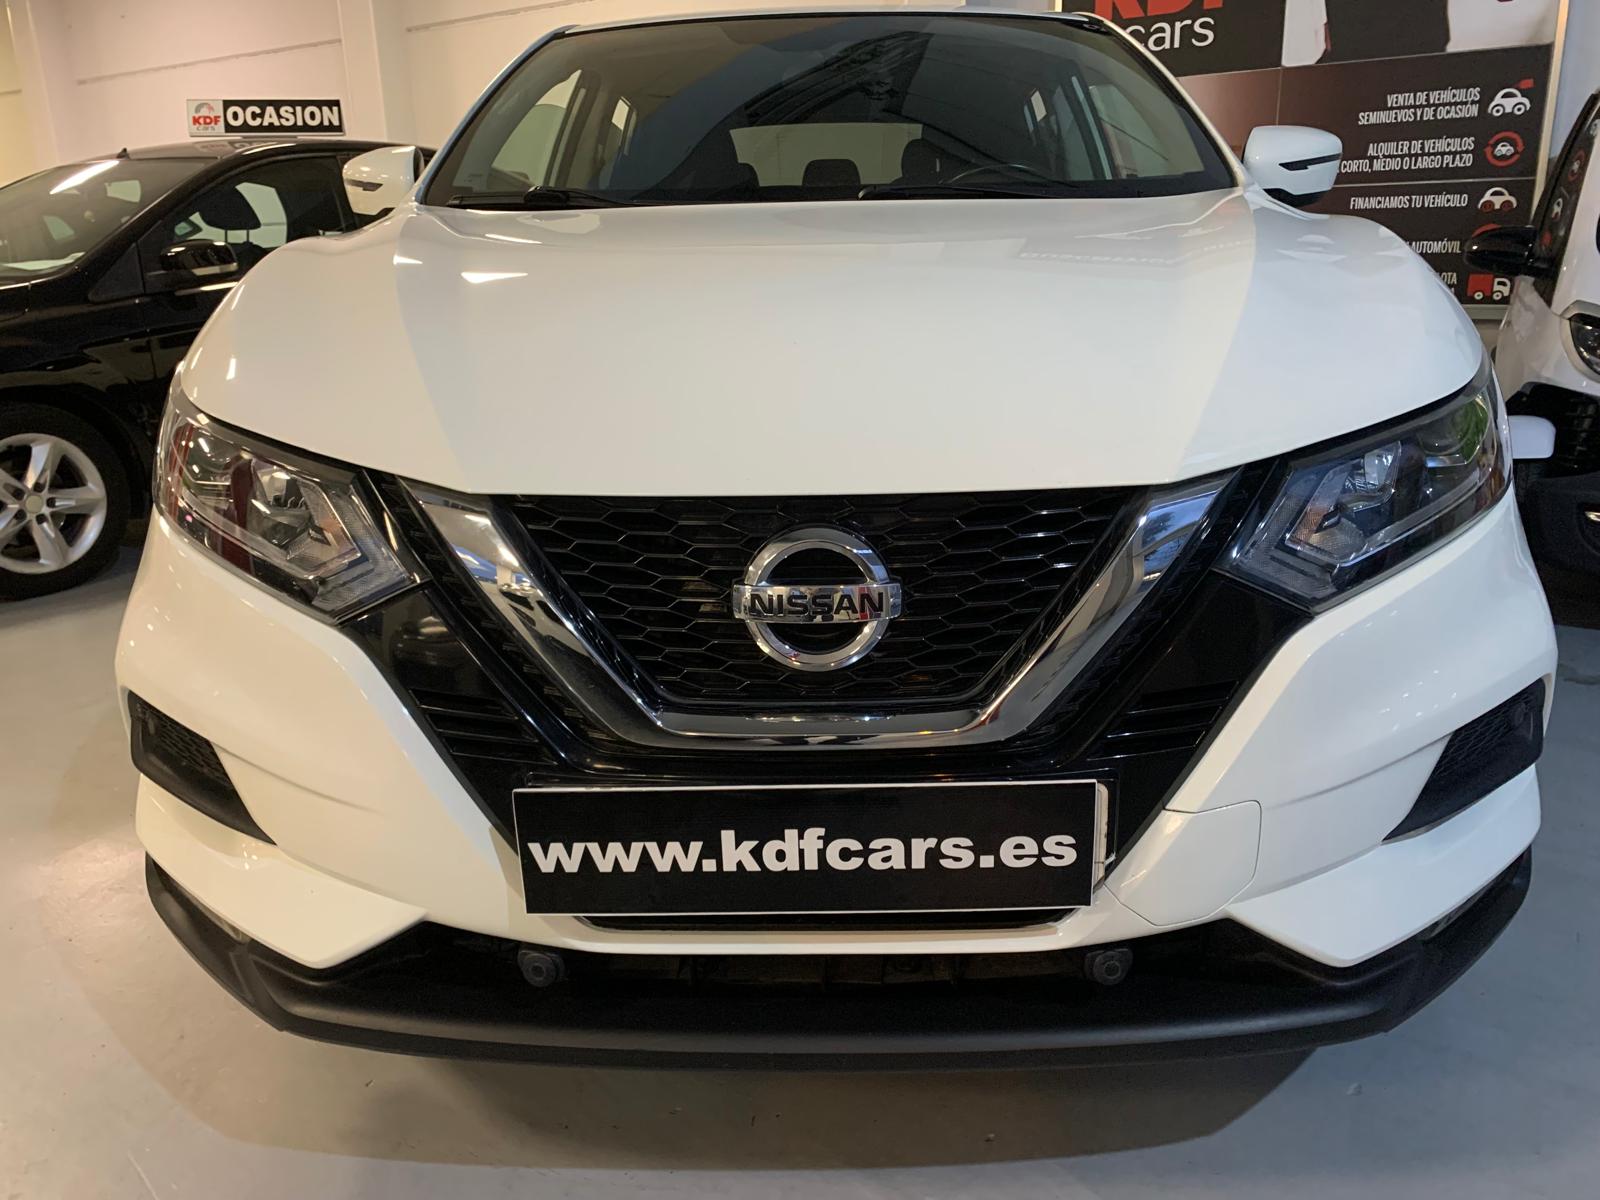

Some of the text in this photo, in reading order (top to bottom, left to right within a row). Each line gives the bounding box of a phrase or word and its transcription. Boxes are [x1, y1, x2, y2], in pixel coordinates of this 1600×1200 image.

[1387, 86, 1481, 107] VENTA DE VEHÍCULOS
[192, 115, 221, 126] KDF
[226, 105, 340, 127] OCASION
[1358, 102, 1479, 125] SEMINUEVOS Y DE OCASIÓN
[1367, 135, 1476, 159] ALQUILER DE VEHÍCULOS
[1341, 153, 1473, 173] CORTO, MEDIO O LARGO PLAZO
[1350, 191, 1468, 210] FINANCIAMOS TU VEHÍCULO
[1411, 237, 1461, 254] AUTOMÓVIL
[1437, 271, 1457, 285] OTA
[750, 592, 883, 616] NISSAN
[527, 828, 1077, 874] www.kdfcars.es
